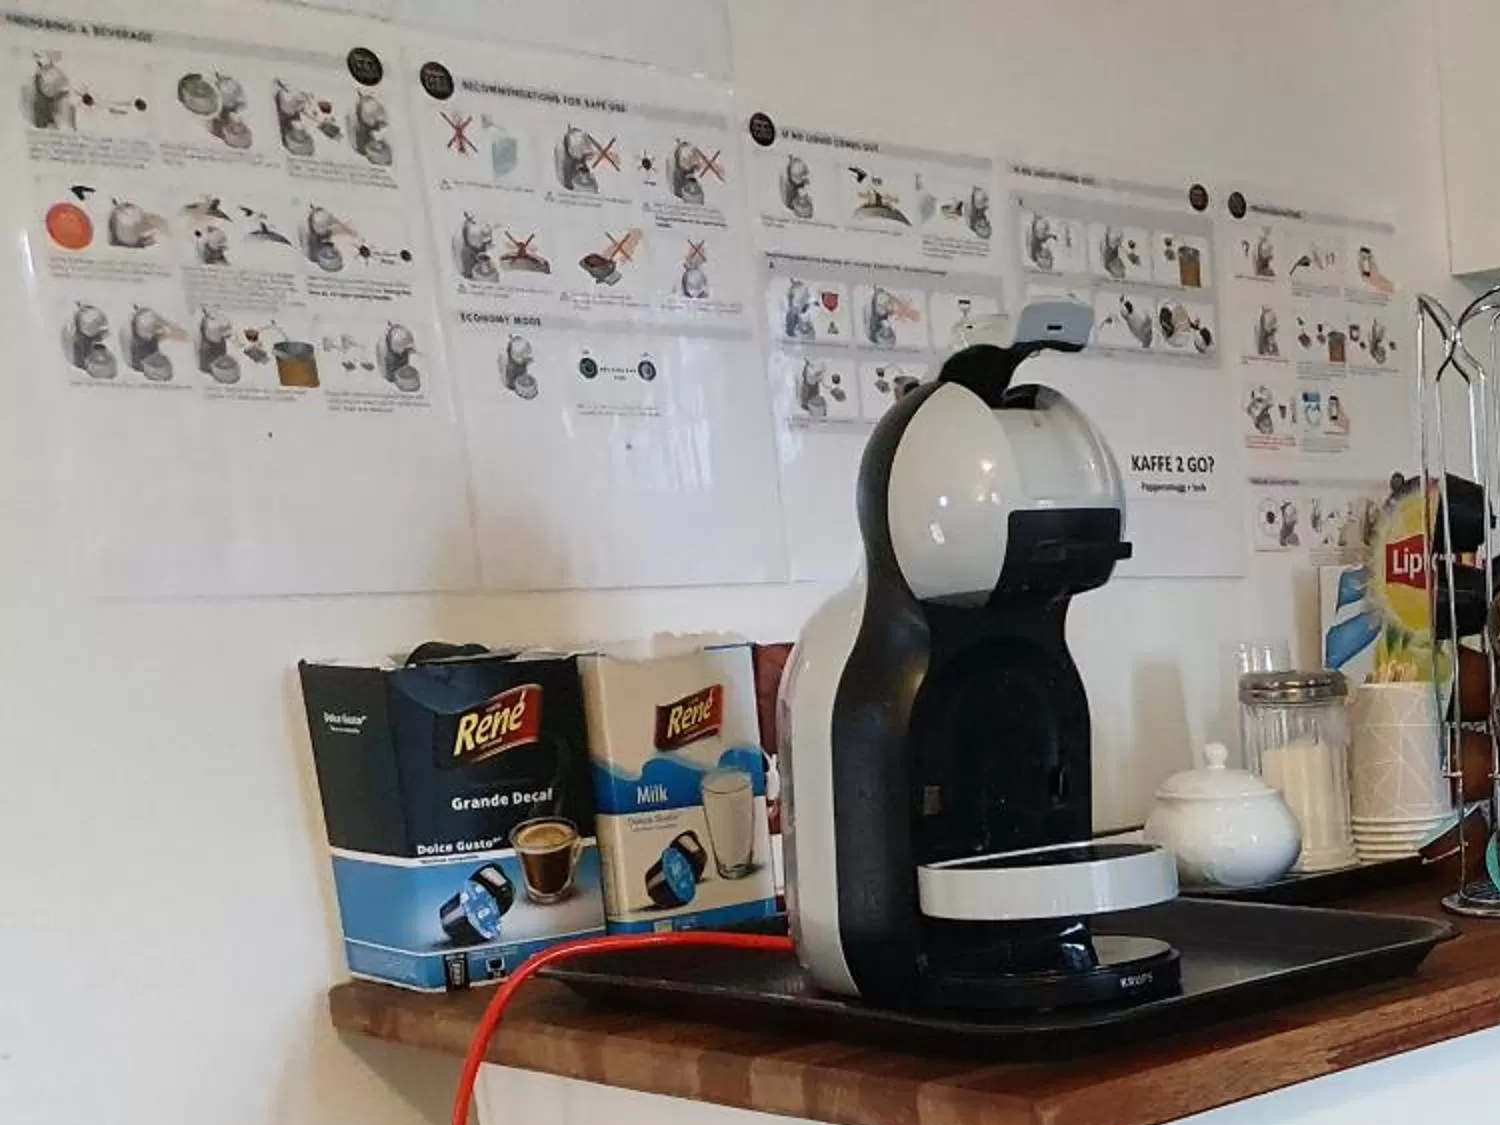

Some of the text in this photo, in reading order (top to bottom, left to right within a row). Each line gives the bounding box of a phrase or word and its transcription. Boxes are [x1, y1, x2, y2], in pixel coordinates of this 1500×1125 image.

[1131, 455, 1215, 473] KAFFE 2 GO?
[1393, 547, 1455, 580] Lip
[453, 689, 527, 757] René
[667, 690, 714, 738] René
[452, 787, 553, 811] Grande Decaf
[637, 784, 669, 804] Milk
[416, 841, 453, 856] Dolce
